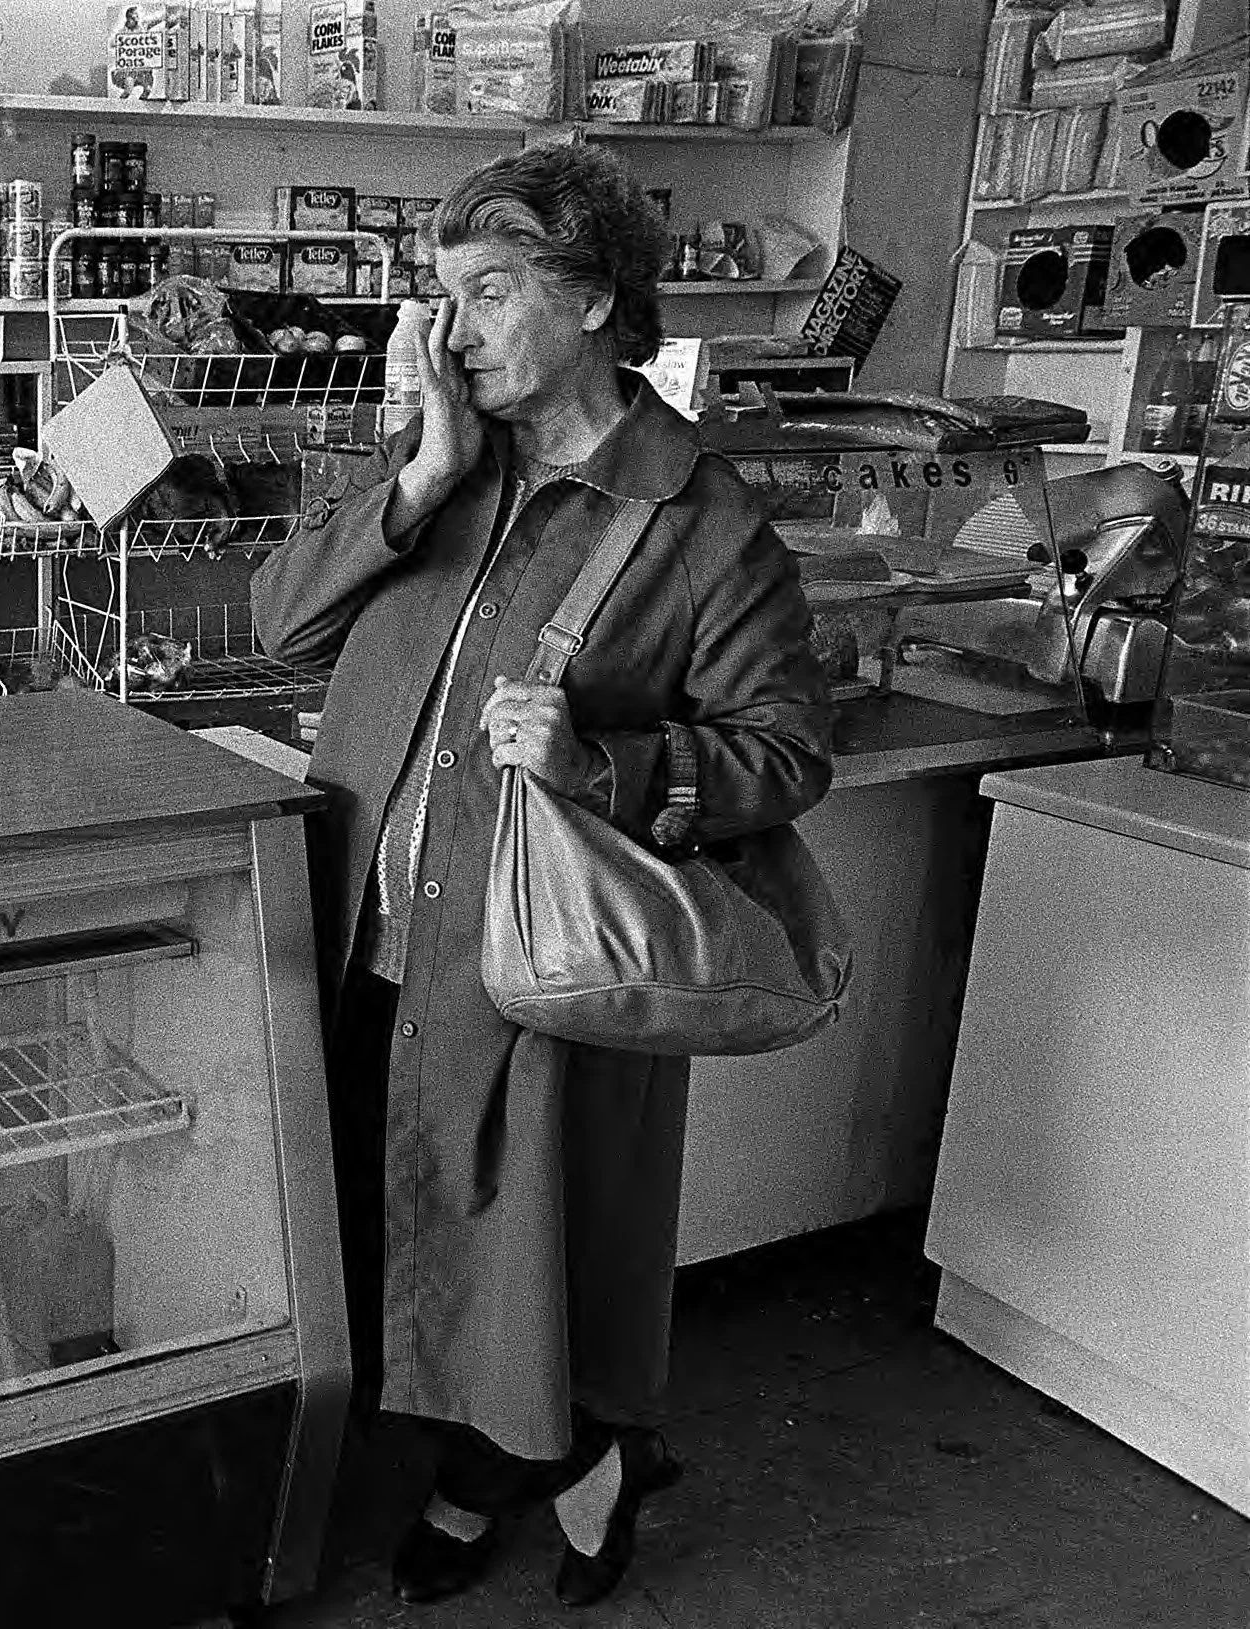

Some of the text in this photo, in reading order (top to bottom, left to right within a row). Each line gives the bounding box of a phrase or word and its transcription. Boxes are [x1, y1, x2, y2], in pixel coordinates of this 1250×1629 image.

[314, 20, 342, 37] CORN
[311, 32, 346, 50] FLAKES
[435, 32, 455, 45] COR
[117, 46, 161, 58] Porage
[433, 45, 455, 58] FLAK
[116, 56, 146, 68] Oats
[597, 51, 665, 76] Weetabix
[309, 190, 337, 206] Tetley
[240, 247, 269, 263] Tetley
[307, 247, 336, 263] Tetley
[802, 250, 860, 345] MAGAZINE
[813, 259, 870, 356] DIRECTORY
[823, 457, 972, 492] cakes
[1196, 513, 1219, 530] 36
